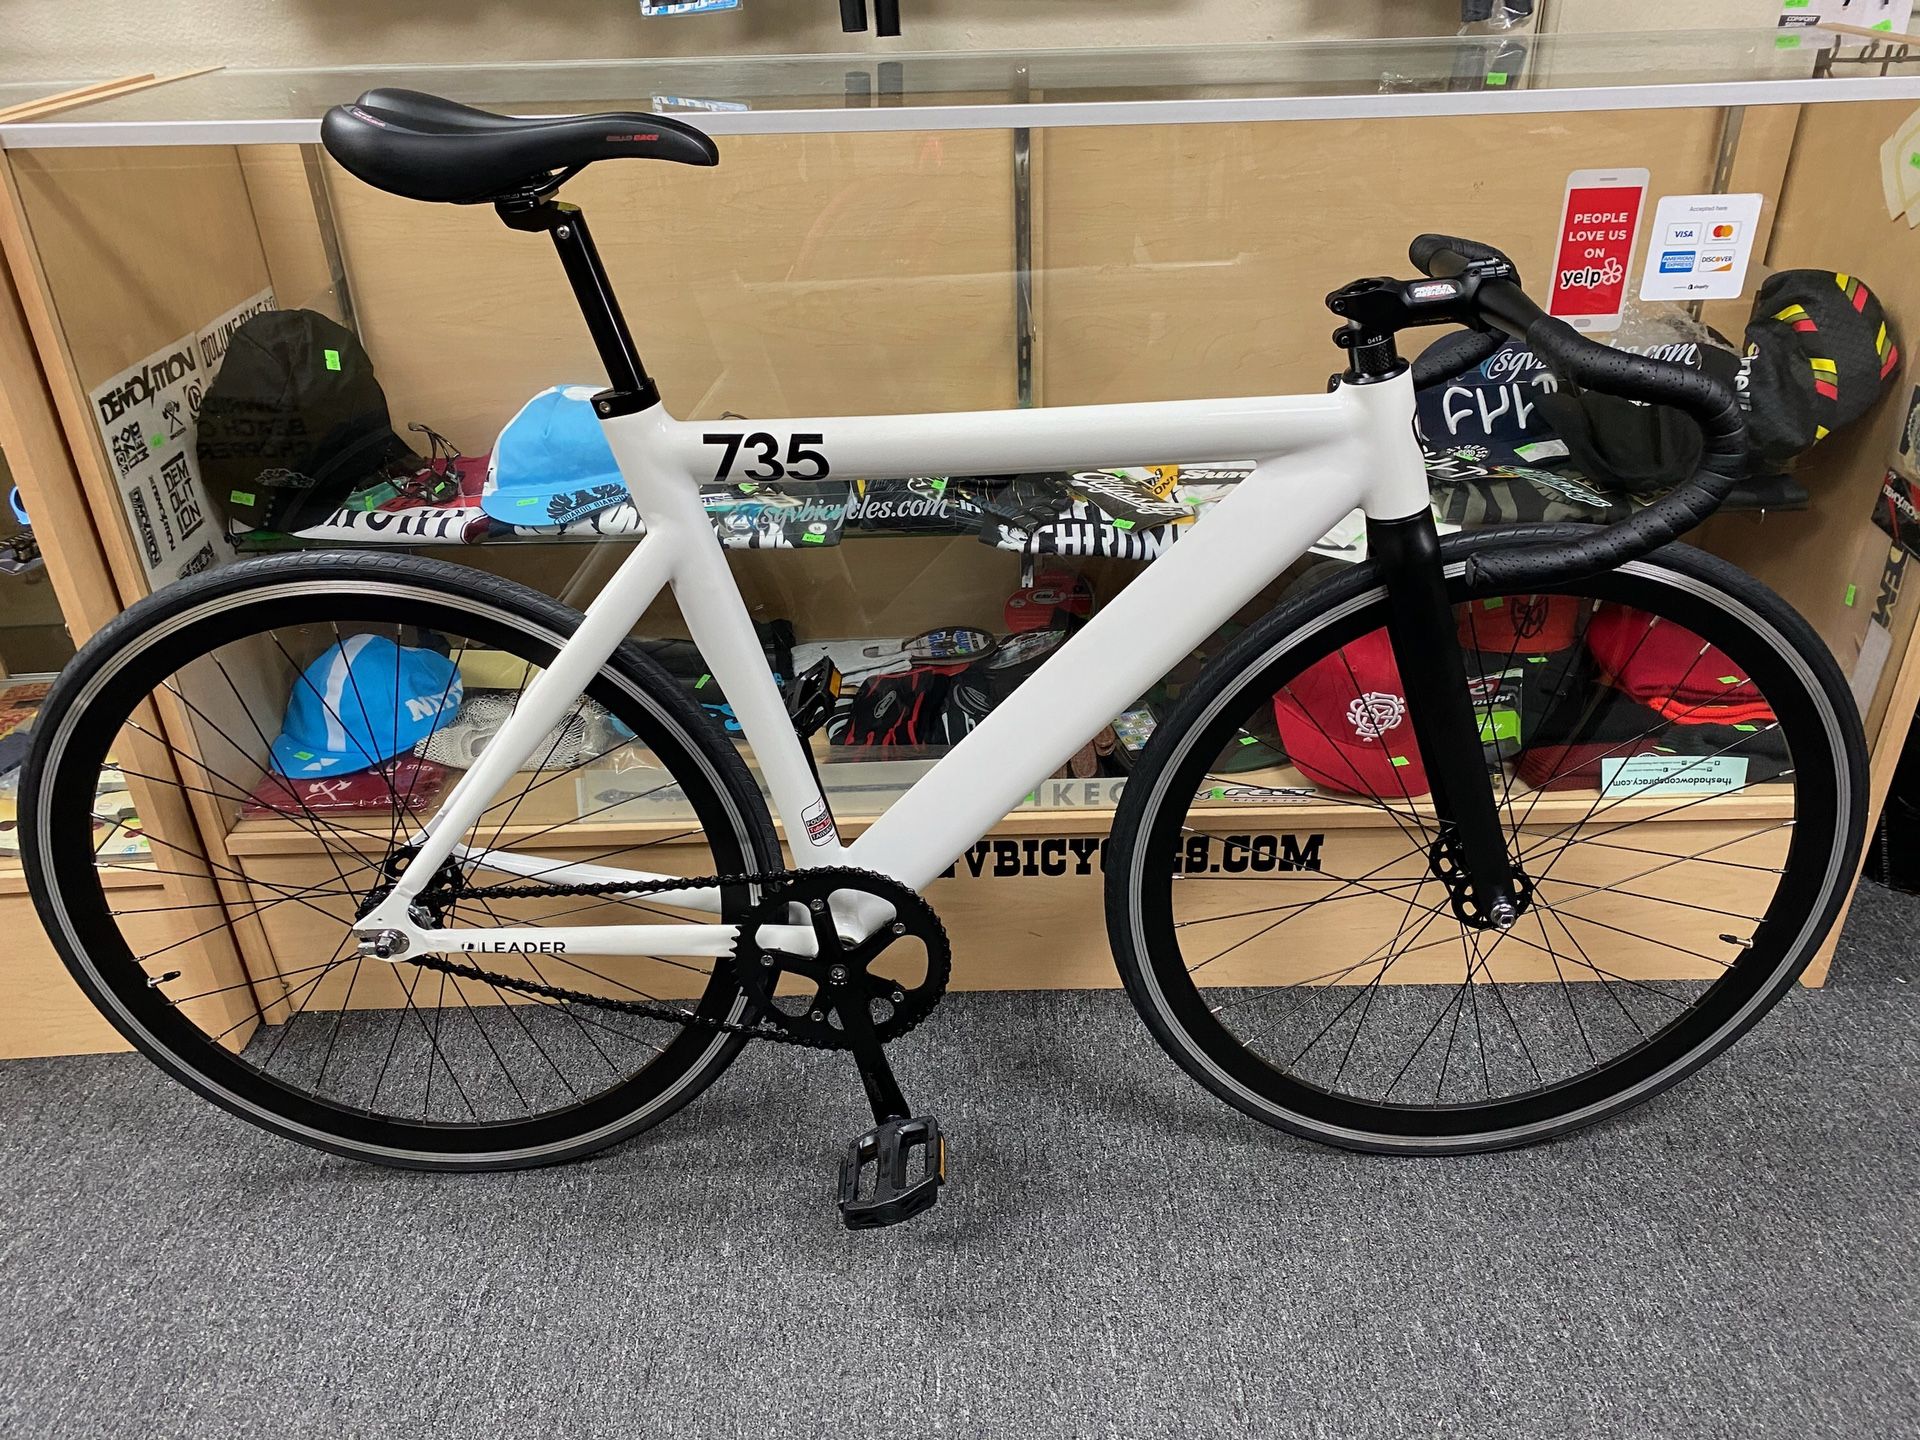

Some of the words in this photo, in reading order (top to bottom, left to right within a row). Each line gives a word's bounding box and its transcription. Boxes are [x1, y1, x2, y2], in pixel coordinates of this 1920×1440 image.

[1573, 212, 1629, 224] PEOPLE
[1567, 230, 1605, 242] LOVE
[1608, 229, 1627, 240] US
[1674, 230, 1694, 238] VISA
[1584, 247, 1606, 258] ON
[1701, 255, 1733, 263] DISCOVER
[1562, 266, 1601, 288] yelp
[98, 346, 196, 426] DEMOLITION
[702, 431, 831, 482] 735
[758, 493, 950, 534] sgvbicycles.com
[1030, 523, 1178, 561] CHROM
[1612, 776, 1732, 787] theshadowconspiracy.com
[481, 941, 566, 954] LEADER
